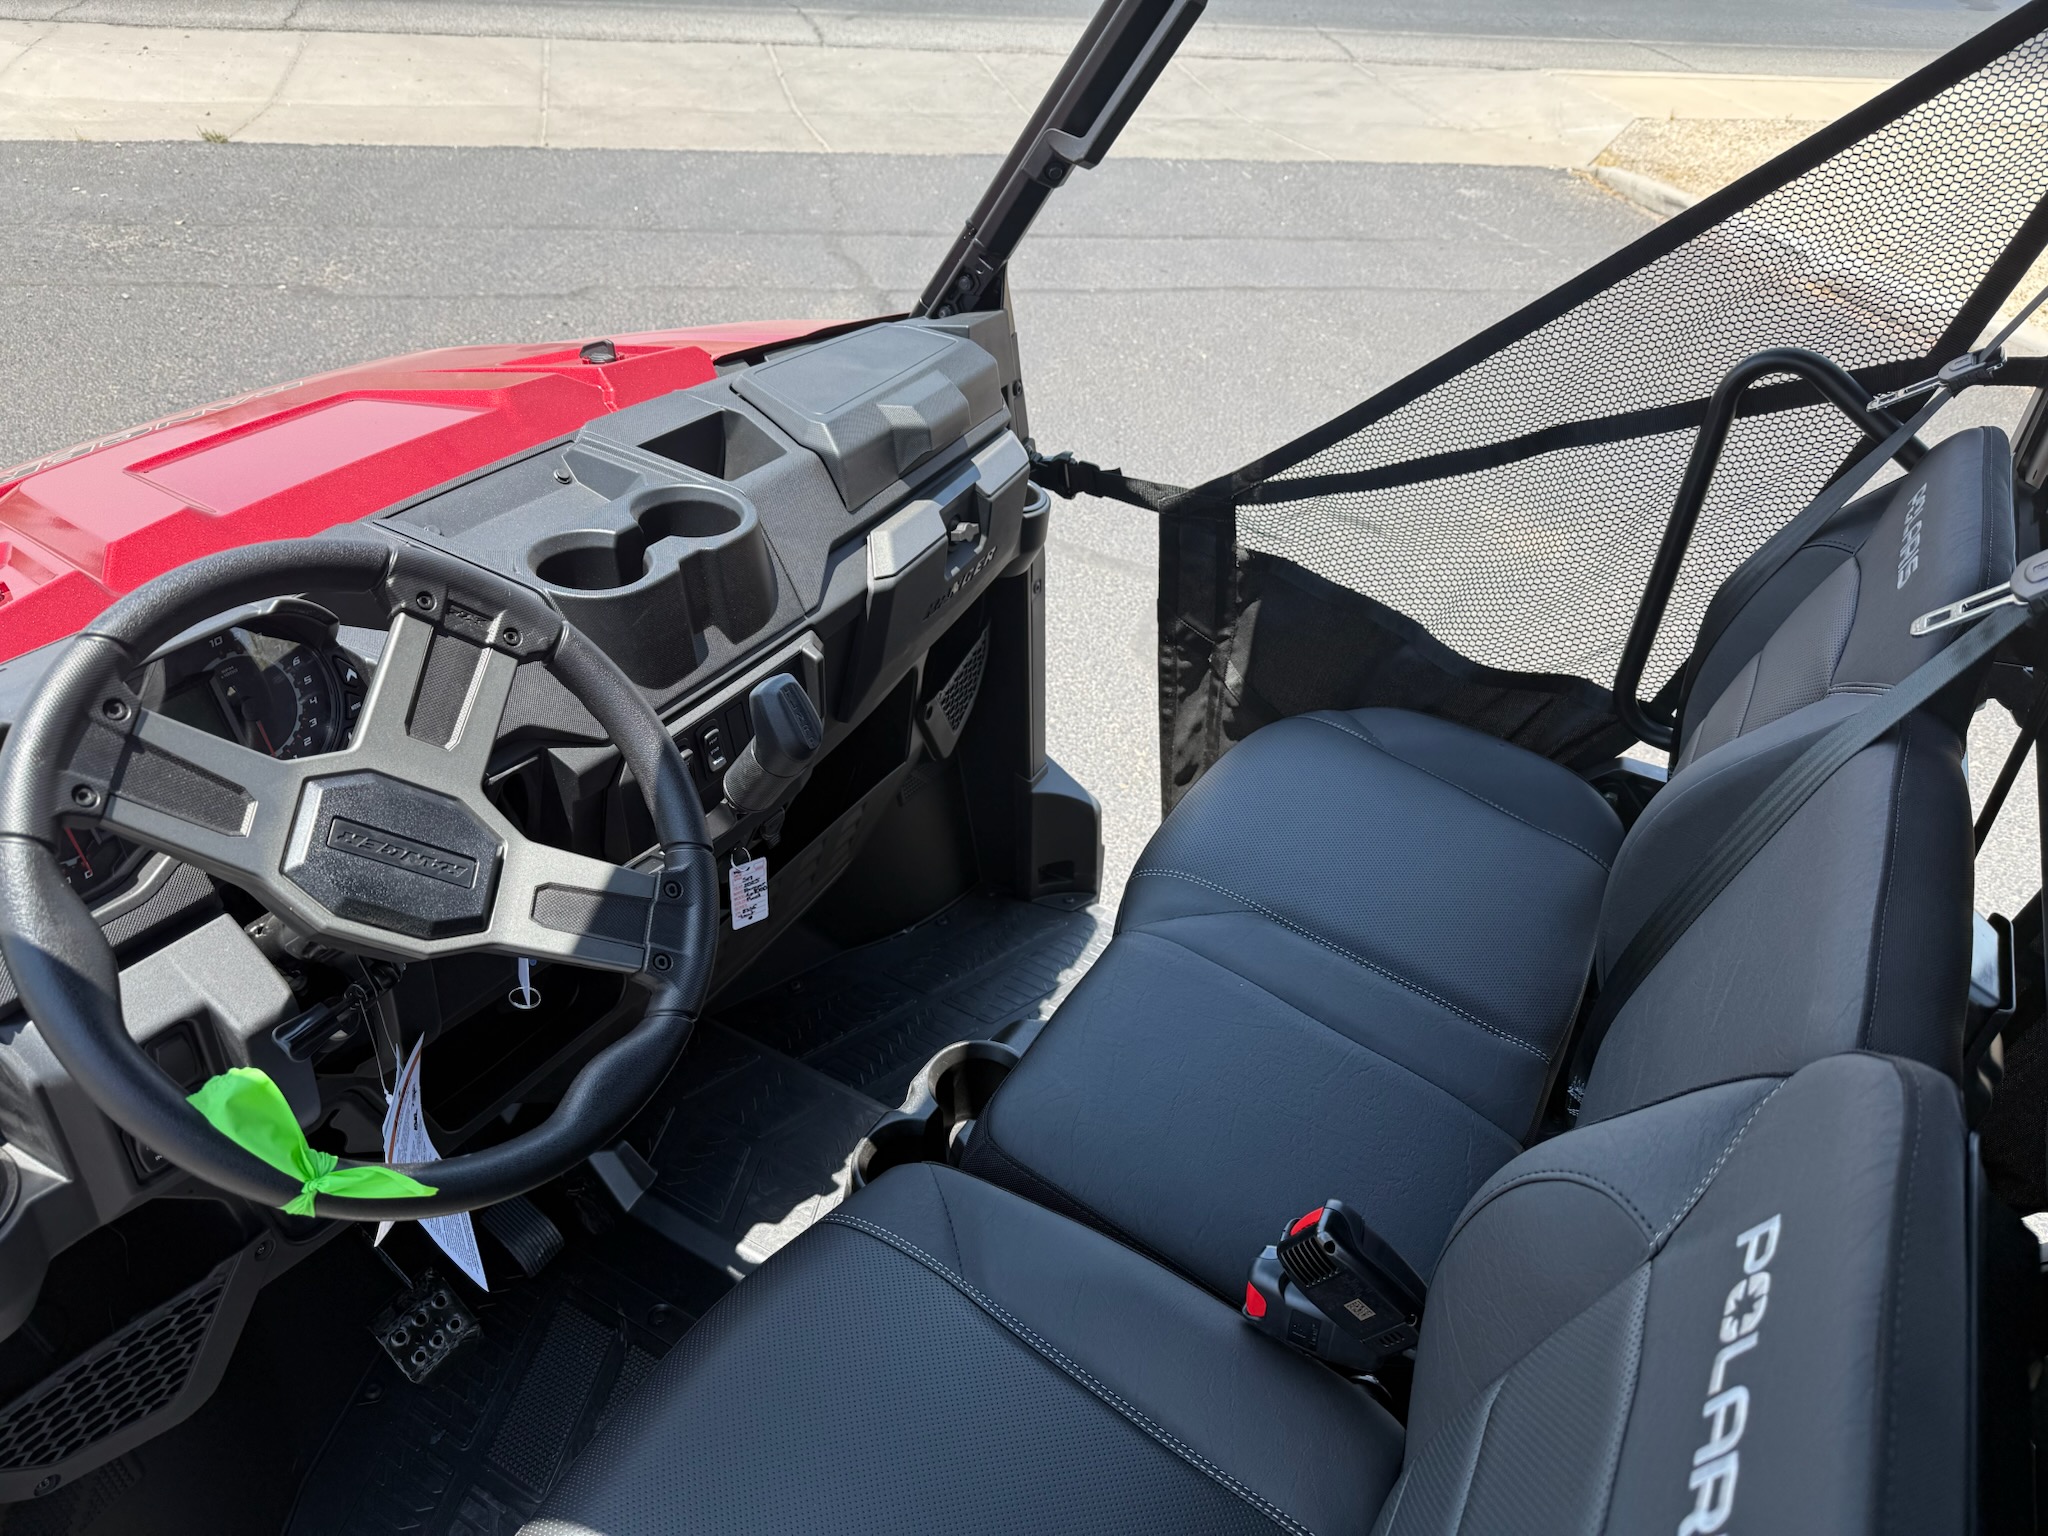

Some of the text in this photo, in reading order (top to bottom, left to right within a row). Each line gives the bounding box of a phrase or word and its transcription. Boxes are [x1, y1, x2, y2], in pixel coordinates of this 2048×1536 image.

[1896, 482, 1928, 590] POLARIS
[922, 545, 997, 622] RANGER
[209, 636, 223, 648] 10
[292, 656, 301, 667] 6
[303, 675, 313, 685] 5
[309, 696, 318, 705] 4
[308, 717, 318, 728] 3
[303, 736, 312, 747] 2
[333, 829, 470, 879] RANGER
[1677, 1213, 1782, 1536] POLAR
